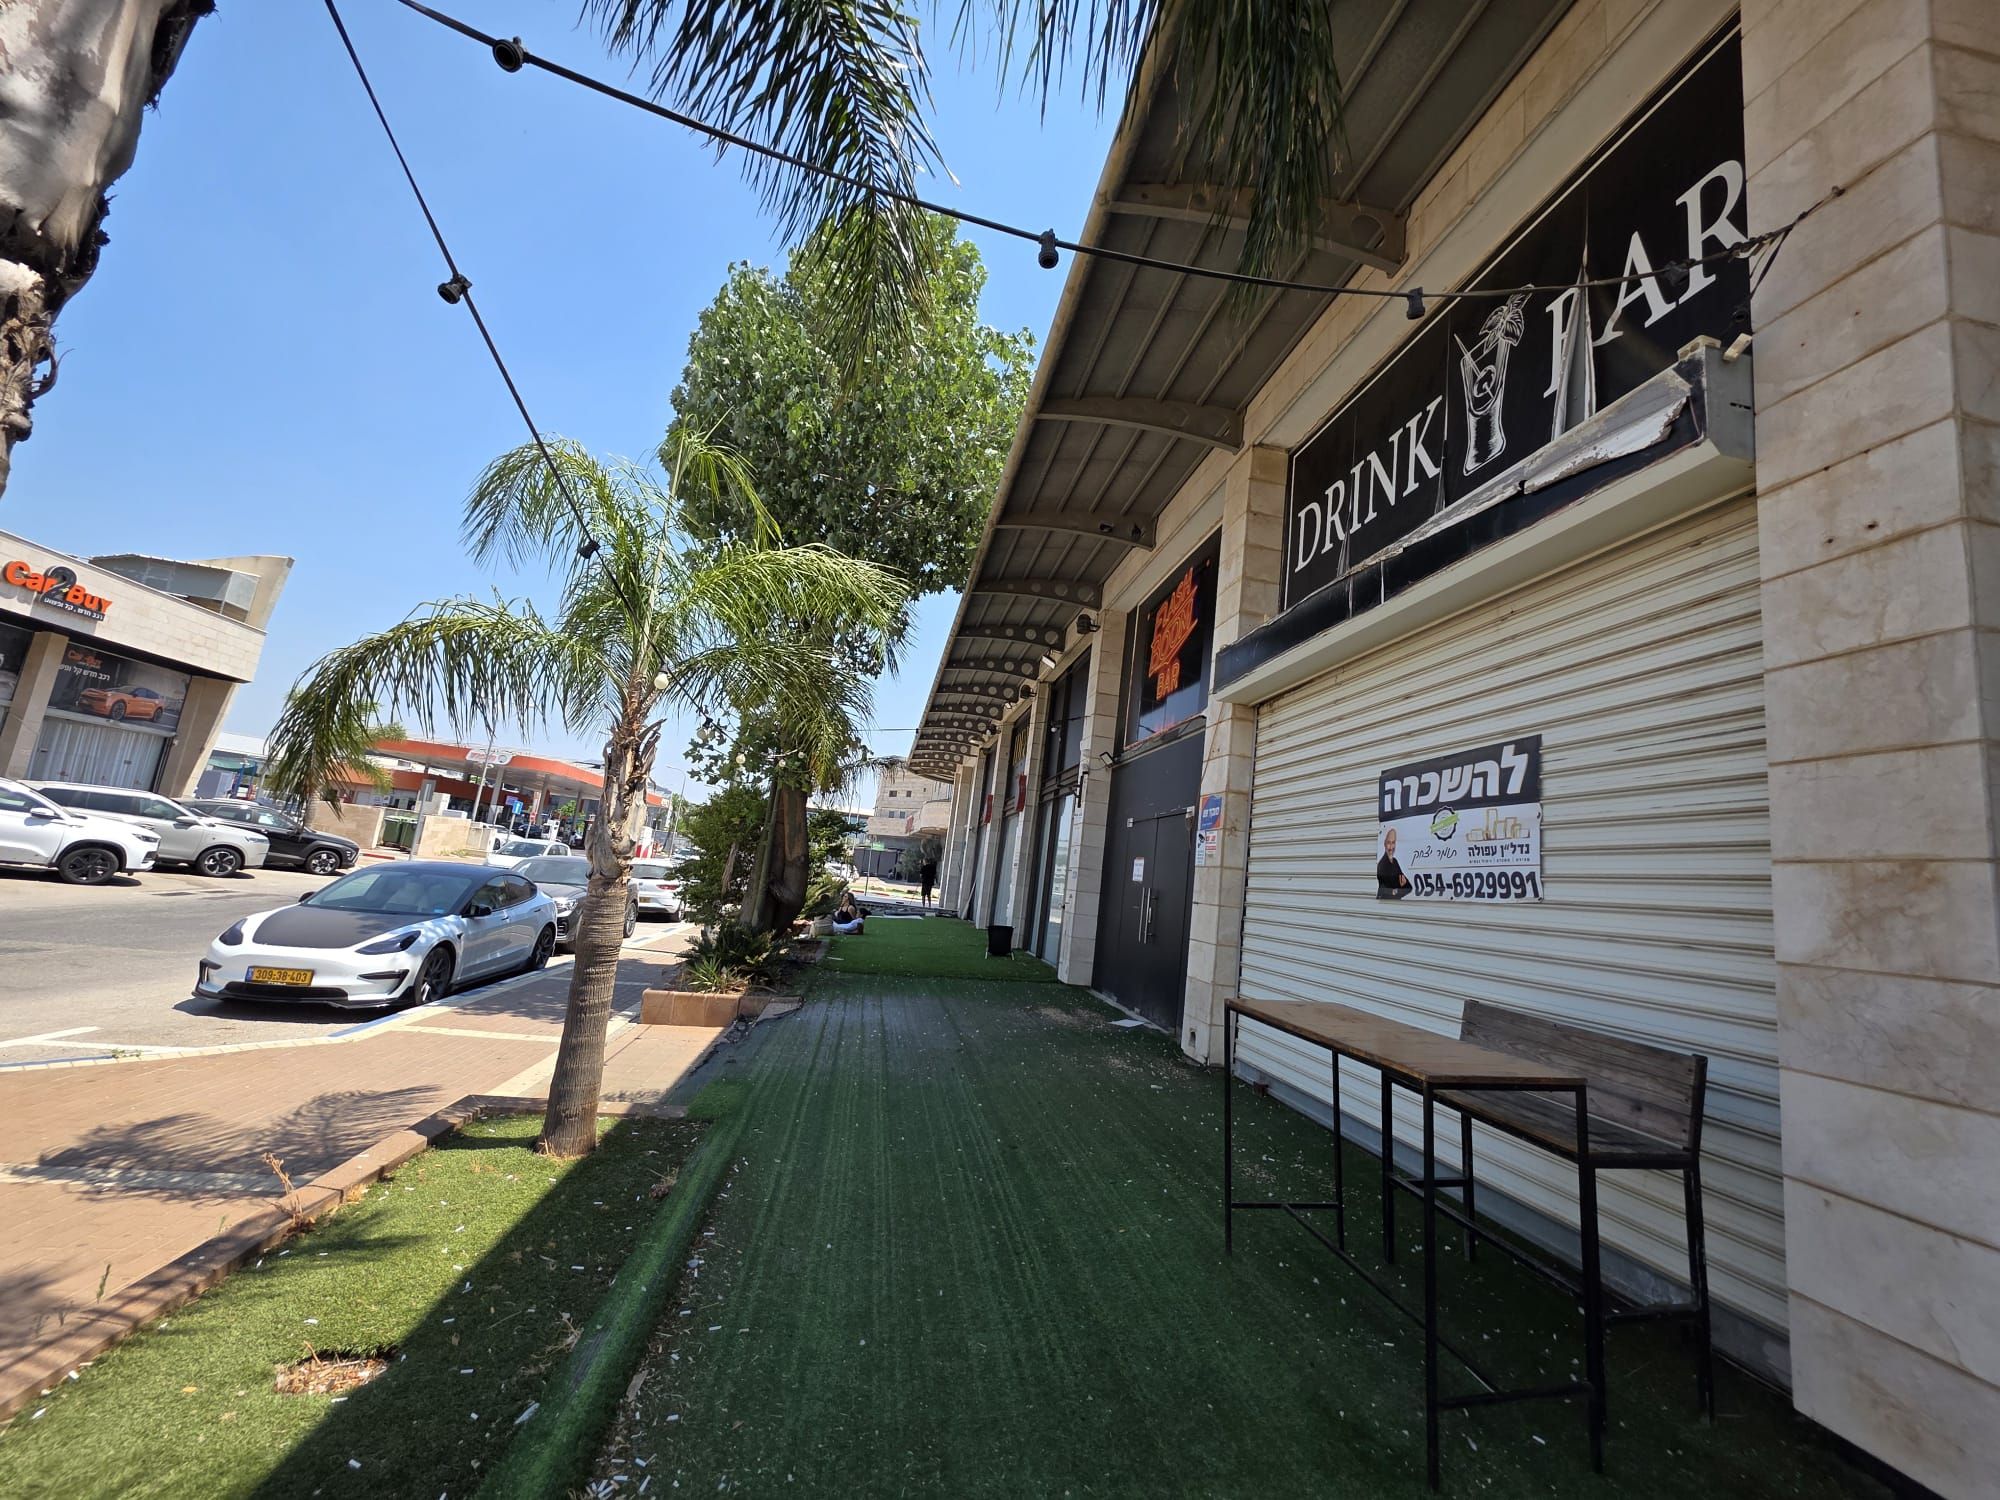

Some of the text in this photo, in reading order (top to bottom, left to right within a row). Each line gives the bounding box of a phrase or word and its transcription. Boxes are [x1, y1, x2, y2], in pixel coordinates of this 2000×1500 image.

[1294, 394, 1443, 574] DRINK
[64, 603, 73, 611] קל
[92, 612, 103, 621] רכב
[73, 666, 83, 676] קל
[83, 669, 98, 678] חדש
[98, 672, 110, 681] רכב
[1156, 662, 1180, 701] BAR
[1384, 744, 1529, 812] להשכרה
[1411, 845, 1433, 866] יצחק
[1468, 842, 1530, 858] נדל"ן עפולה
[1413, 871, 1540, 899] 054-6929991
[256, 969, 308, 982] 309-38-403
